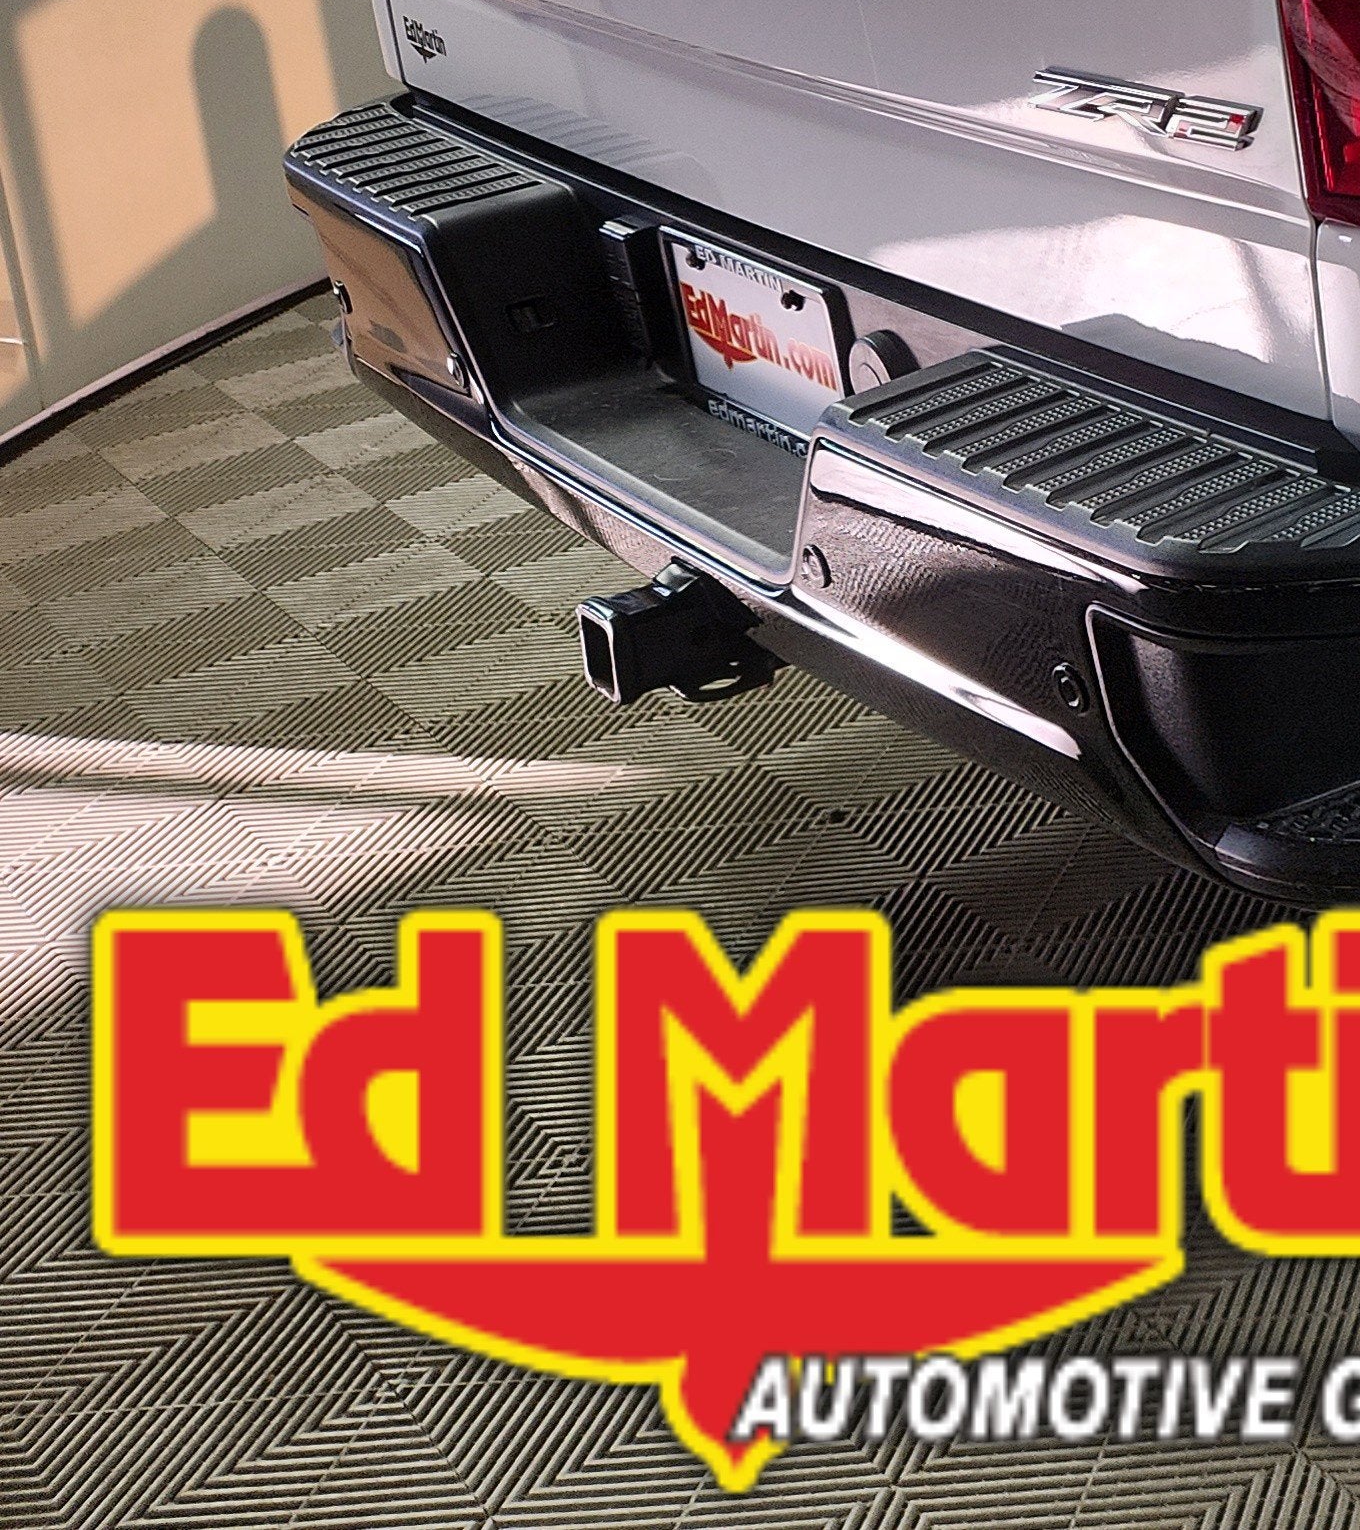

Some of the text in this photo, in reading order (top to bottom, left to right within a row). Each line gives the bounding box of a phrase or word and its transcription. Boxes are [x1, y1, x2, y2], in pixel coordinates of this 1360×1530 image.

[1028, 66, 1264, 152] ZR2
[694, 244, 784, 294] ED MARTIN
[707, 399, 807, 458] edmartin.c
